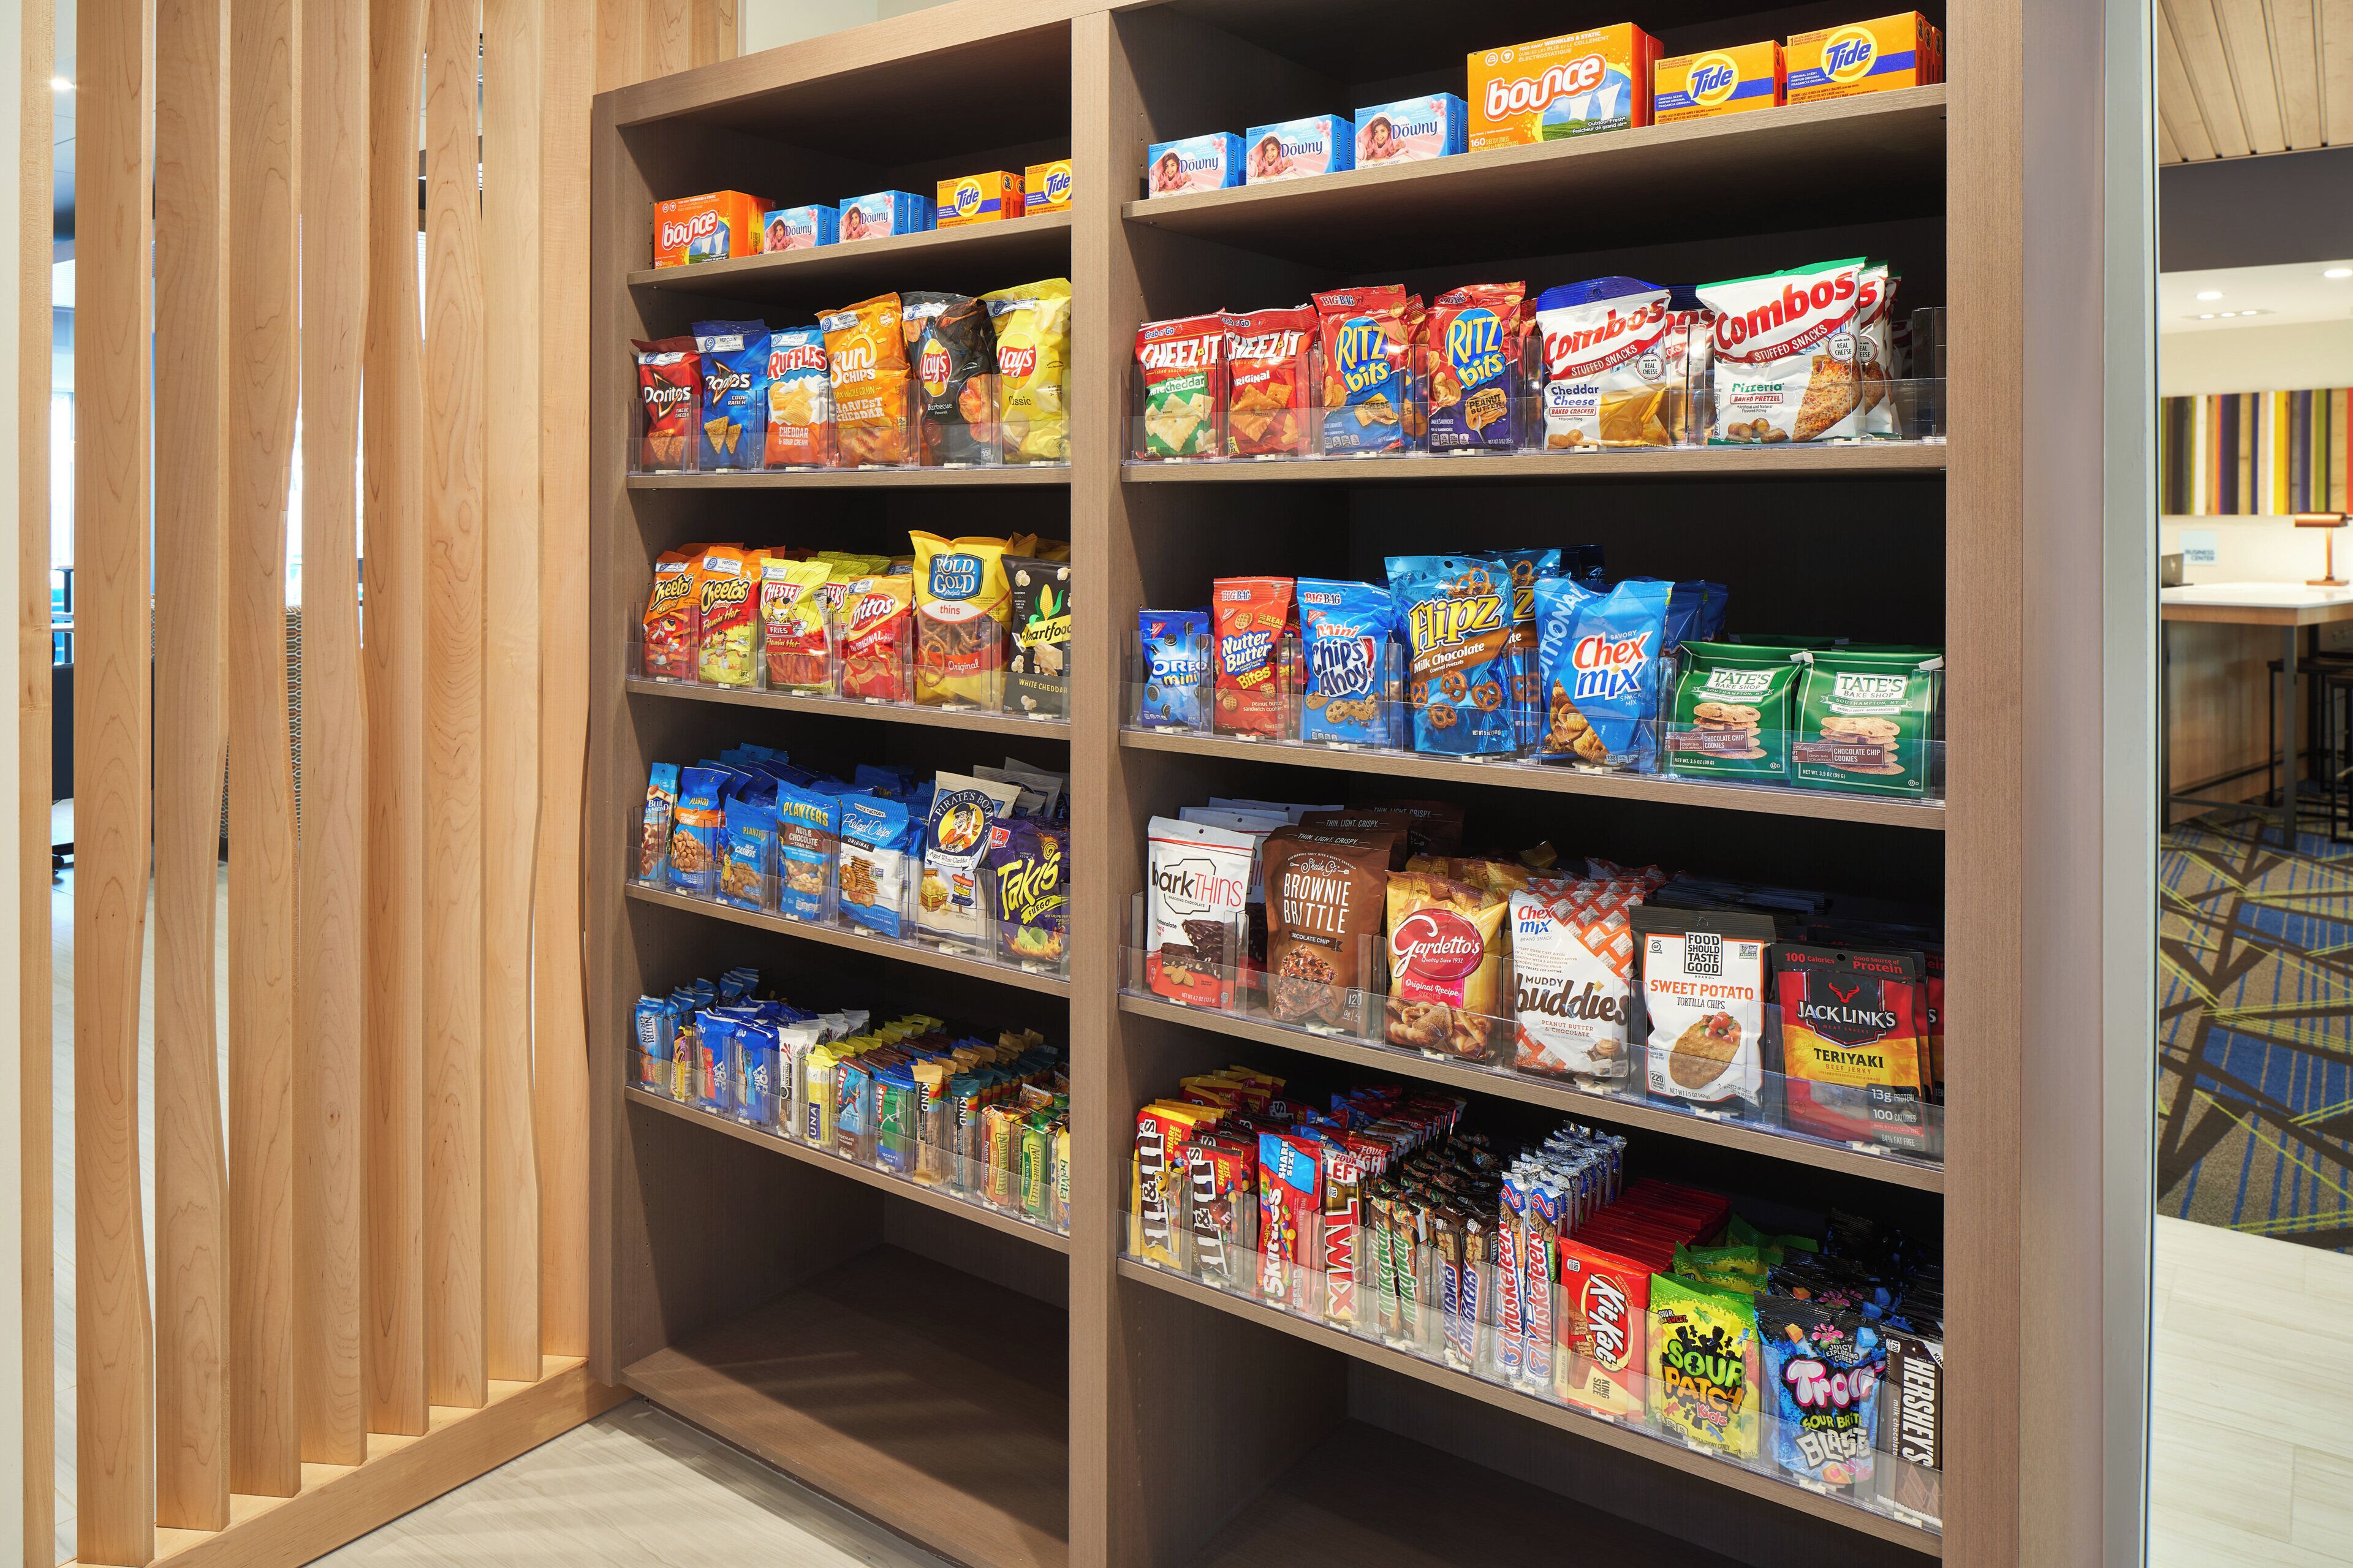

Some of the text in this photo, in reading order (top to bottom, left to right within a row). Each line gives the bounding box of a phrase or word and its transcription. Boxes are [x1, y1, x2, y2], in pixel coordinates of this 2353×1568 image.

[1544, 36, 1575, 47] WRINKLES
[1580, 31, 1601, 40] STATIC
[1825, 38, 1871, 77] Tide
[1486, 55, 1603, 118] bounce
[1691, 65, 1734, 101] Tide
[1391, 119, 1438, 140] Downy
[1280, 139, 1324, 159] Downy
[1471, 137, 1486, 147] 160
[1180, 155, 1219, 174] Downy
[956, 187, 979, 212] Tide
[860, 211, 888, 225] Downy
[662, 211, 719, 248] bounce
[1320, 295, 1355, 306] BIG BAG
[1715, 271, 1855, 350] Combos
[1448, 317, 1501, 366] RITZ
[1544, 298, 1665, 368] Combos
[1754, 325, 1828, 362] STUFFED SNACKS
[1335, 325, 1387, 371] RITZ
[767, 346, 827, 380] RUFFLES
[830, 334, 877, 389] Sun
[922, 354, 947, 384] Lay's
[1000, 346, 1034, 379] Lay's
[1457, 353, 1504, 388] bits
[1571, 344, 1638, 377] STUFFED SNACKS
[843, 368, 876, 384] CHIPS
[1344, 362, 1389, 392] bits
[644, 387, 692, 404] Doritos
[1551, 384, 1599, 395] Cheddar
[1732, 382, 1783, 393] Pizzeria
[927, 403, 953, 411] Barbecue
[1469, 393, 1501, 409] PEANUT
[779, 426, 809, 438] CHEDDAR
[935, 557, 975, 574] ROLD
[933, 574, 976, 594] GOLD
[701, 581, 751, 613] Cheetos
[724, 608, 741, 621] Hot
[939, 605, 961, 615] thins
[1316, 623, 1360, 638] Mini
[1610, 630, 1637, 640] SAVORY
[1221, 632, 1270, 654] Nutter
[1574, 634, 1648, 669] Chex
[948, 659, 980, 674] Original
[1226, 643, 1273, 673] Butter
[1313, 639, 1363, 674] Chips
[1414, 641, 1485, 673] Milk Chocolate
[1153, 661, 1208, 675] OREO
[1235, 665, 1272, 691] Bites
[1712, 670, 1772, 685] TATE'S
[1018, 678, 1068, 694] WHITE CHEDDAR
[1163, 671, 1198, 687] mini
[1839, 675, 1904, 693] TATE'S
[782, 801, 829, 827] PLANTERS
[934, 792, 976, 817] PIRATE'S
[842, 812, 893, 841] Pretzel Crisps
[789, 833, 819, 846] CHOCOLATE
[847, 838, 870, 849] ORIGINAL
[997, 852, 1062, 921] Takis
[1284, 873, 1352, 907] BROWNIE
[1028, 900, 1051, 917] FUEGO
[1284, 900, 1349, 934] BRITTLE
[1518, 905, 1554, 920] Chex
[1519, 919, 1553, 935] mix
[1391, 915, 1481, 979] Gardetto's
[1687, 944, 1720, 955] SHOULD
[1688, 934, 1720, 945] FOOD
[1686, 962, 1719, 974] GOOD
[1687, 953, 1720, 964] TASTE
[1785, 952, 1835, 965] 100 Calories
[1852, 961, 1903, 974] Protein
[1405, 979, 1460, 998] Original Recipe
[1525, 975, 1564, 987] MUDDY
[1650, 979, 1754, 1000] SWEET POTATO
[1517, 972, 1629, 1026] buddies
[1677, 997, 1726, 1010] TORTILLA CHIPS
[1797, 1000, 1896, 1029] JACK LINK'S
[645, 1016, 654, 1044] NUTRI
[1813, 1048, 1884, 1069] TERIYAKI
[1825, 1063, 1872, 1075] BEEF JERKY
[920, 1082, 930, 1112] KIND
[998, 1134, 1010, 1194] NATURE VALLEY
[1279, 1141, 1289, 1180] SHARE
[1060, 1159, 1070, 1200] belVita
[1325, 1197, 1361, 1317] TWIX
[1528, 1227, 1551, 1344] Musketeers
[1458, 1259, 1477, 1357] SNICKERS
[1826, 1350, 1859, 1360] EXPLODING
[1829, 1343, 1852, 1352] JUICY
[1667, 1339, 1742, 1386] SOUR
[1834, 1355, 1854, 1365] CUBES
[1663, 1365, 1746, 1412] PATCH
[1696, 1402, 1728, 1427] Kids
[1901, 1356, 1936, 1468] HERSHEY'S
